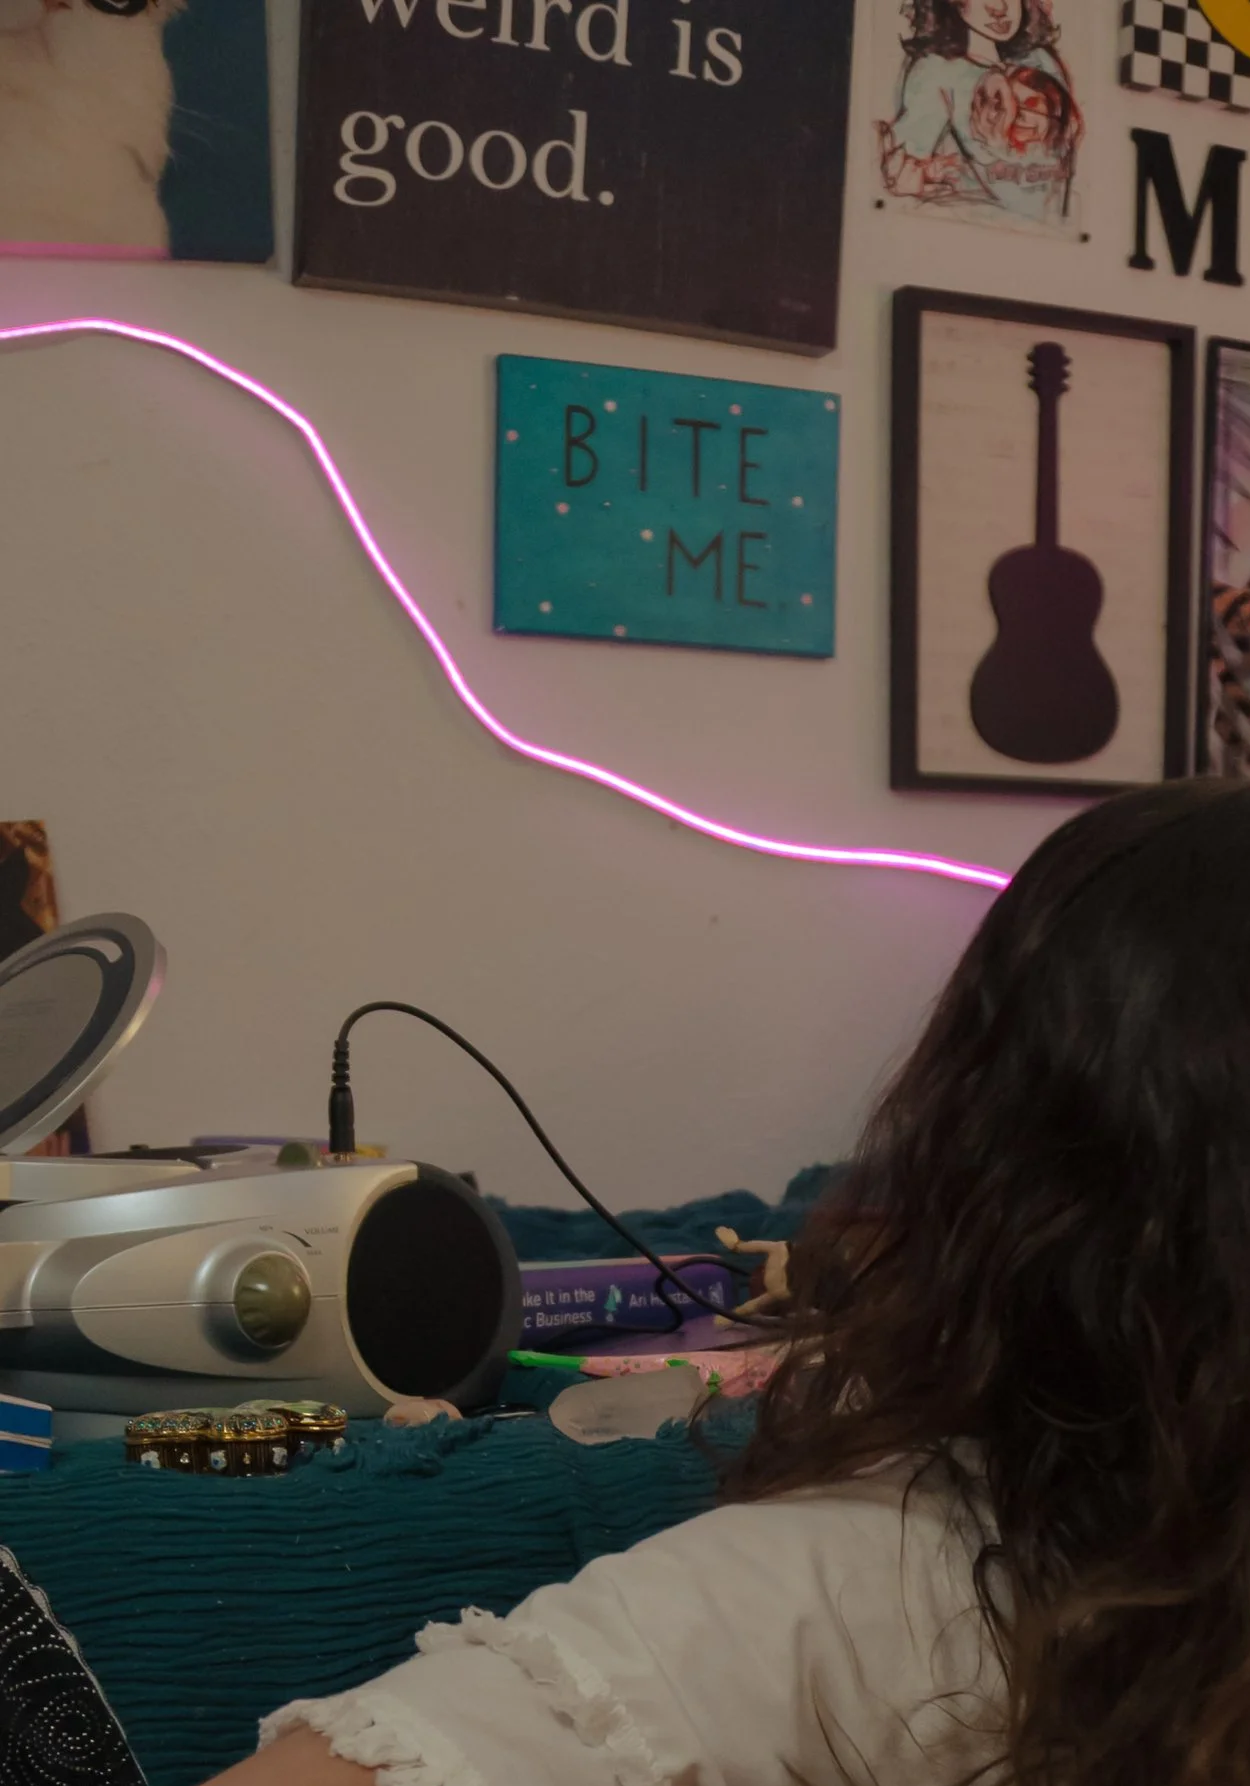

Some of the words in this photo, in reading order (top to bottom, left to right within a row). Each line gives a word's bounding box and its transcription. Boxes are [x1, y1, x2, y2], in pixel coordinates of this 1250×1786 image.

[669, 0, 744, 87] is
[332, 108, 616, 207] good.
[1128, 128, 1247, 287] M
[564, 404, 770, 506] BITE
[666, 527, 769, 609] ME
[536, 1311, 593, 1328] Business
[558, 1289, 571, 1303] in
[574, 1287, 596, 1303] the
